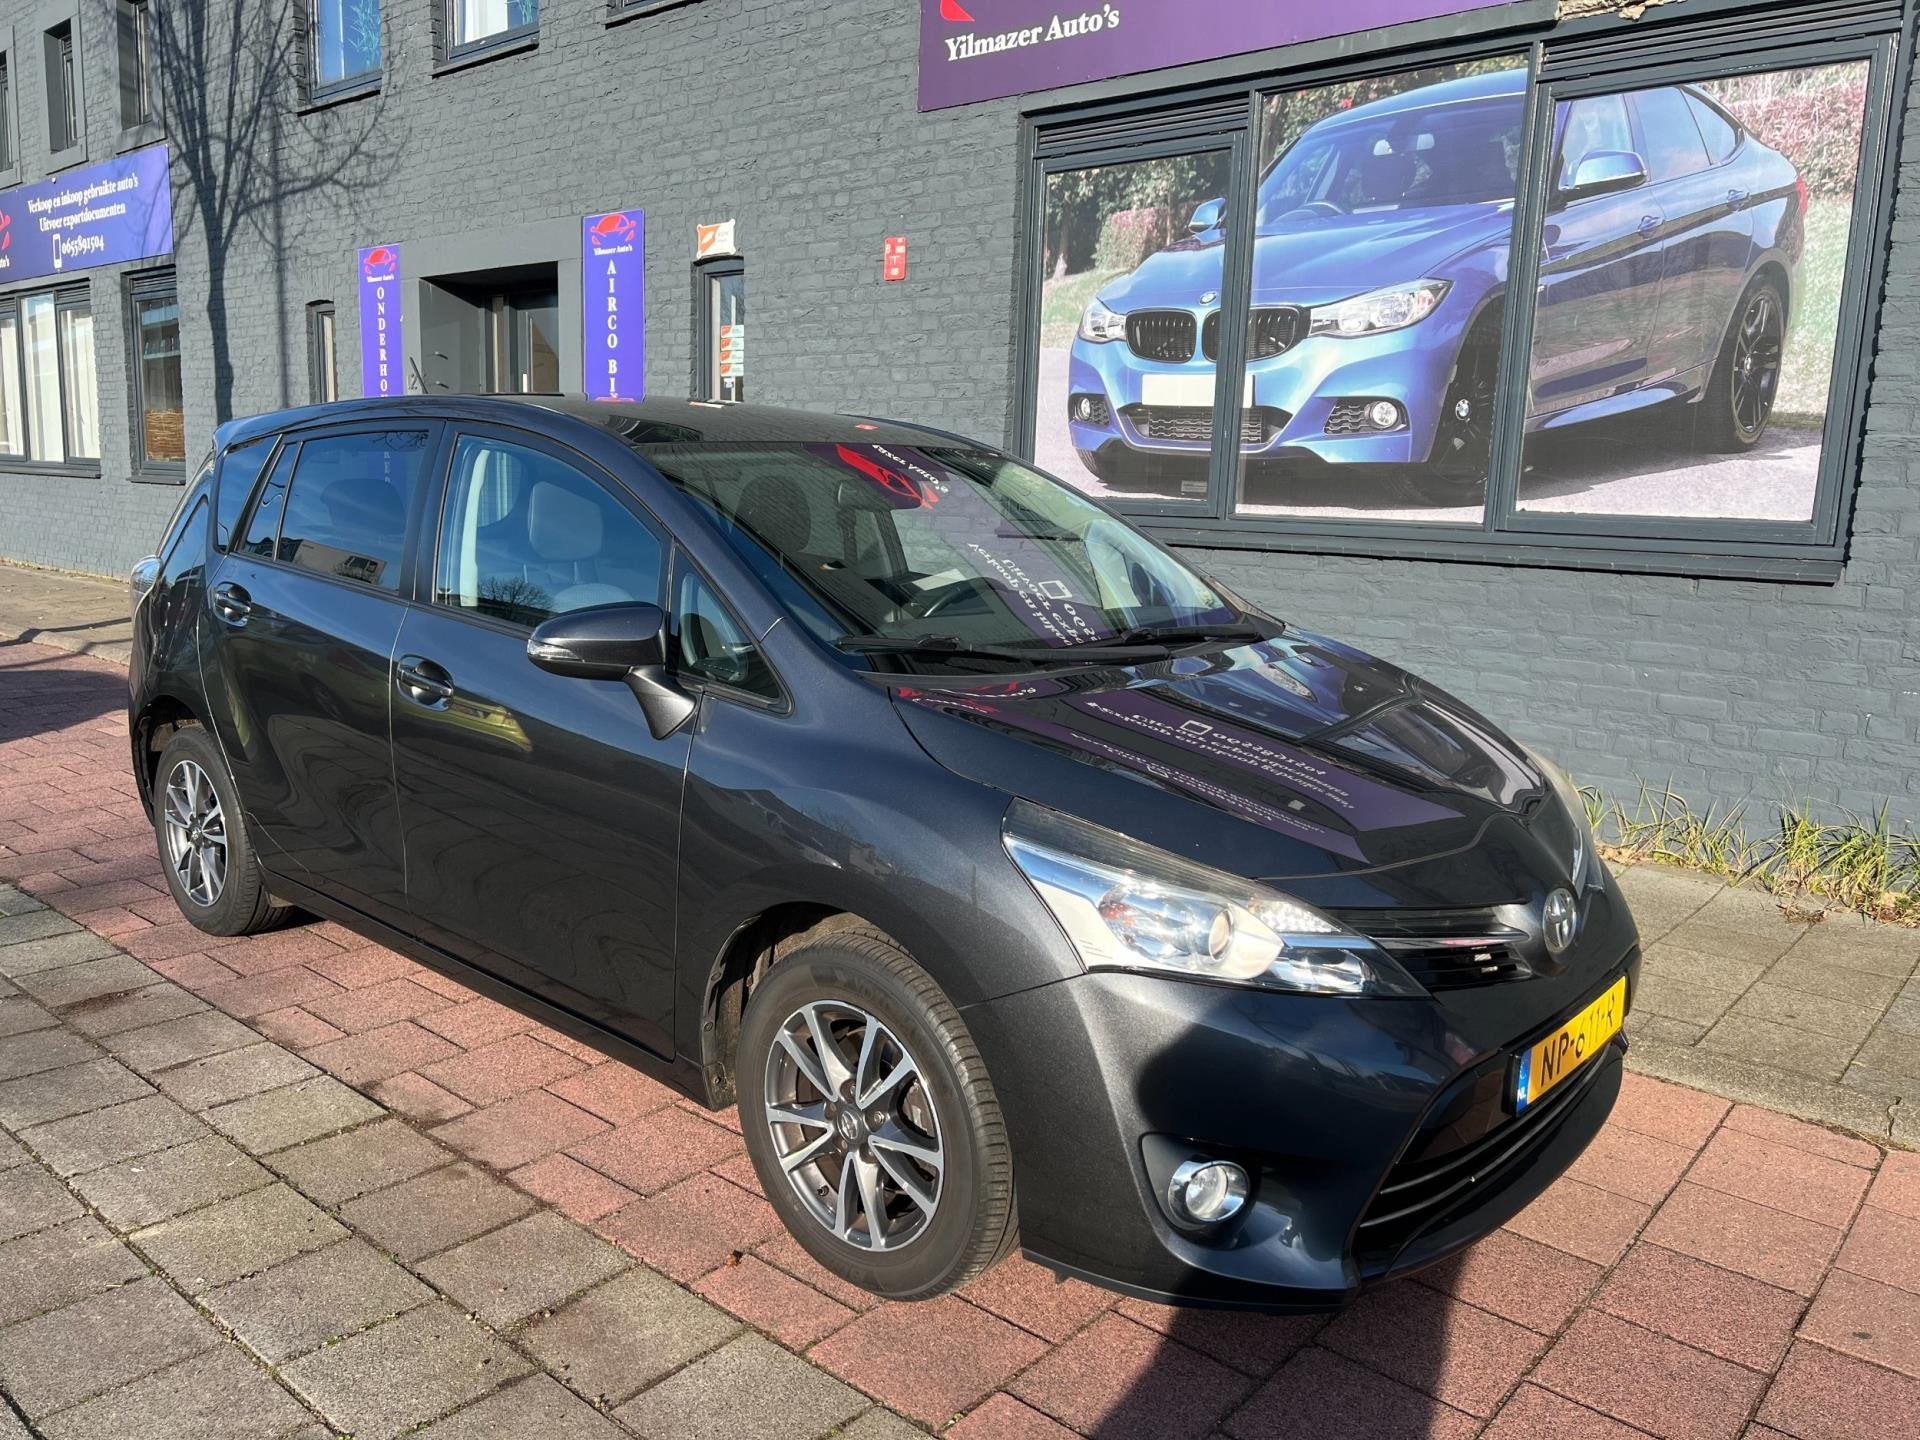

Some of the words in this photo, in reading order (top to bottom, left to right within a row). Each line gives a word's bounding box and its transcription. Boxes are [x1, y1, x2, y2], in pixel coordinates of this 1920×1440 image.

[945, 25, 1043, 61] Yilmazer
[1044, 4, 1120, 41] Auto's
[28, 198, 52, 214] Verkoop
[53, 197, 61, 207] en
[60, 189, 83, 206] inkoop
[84, 181, 116, 205] gebruikte
[117, 173, 138, 191] auto's
[39, 215, 63, 232] Uitvoer
[63, 202, 126, 230] exportdocumenten
[62, 235, 104, 256] 0655891504
[606, 259, 618, 349] AIRCO
[376, 286, 389, 398] ONDERHO
